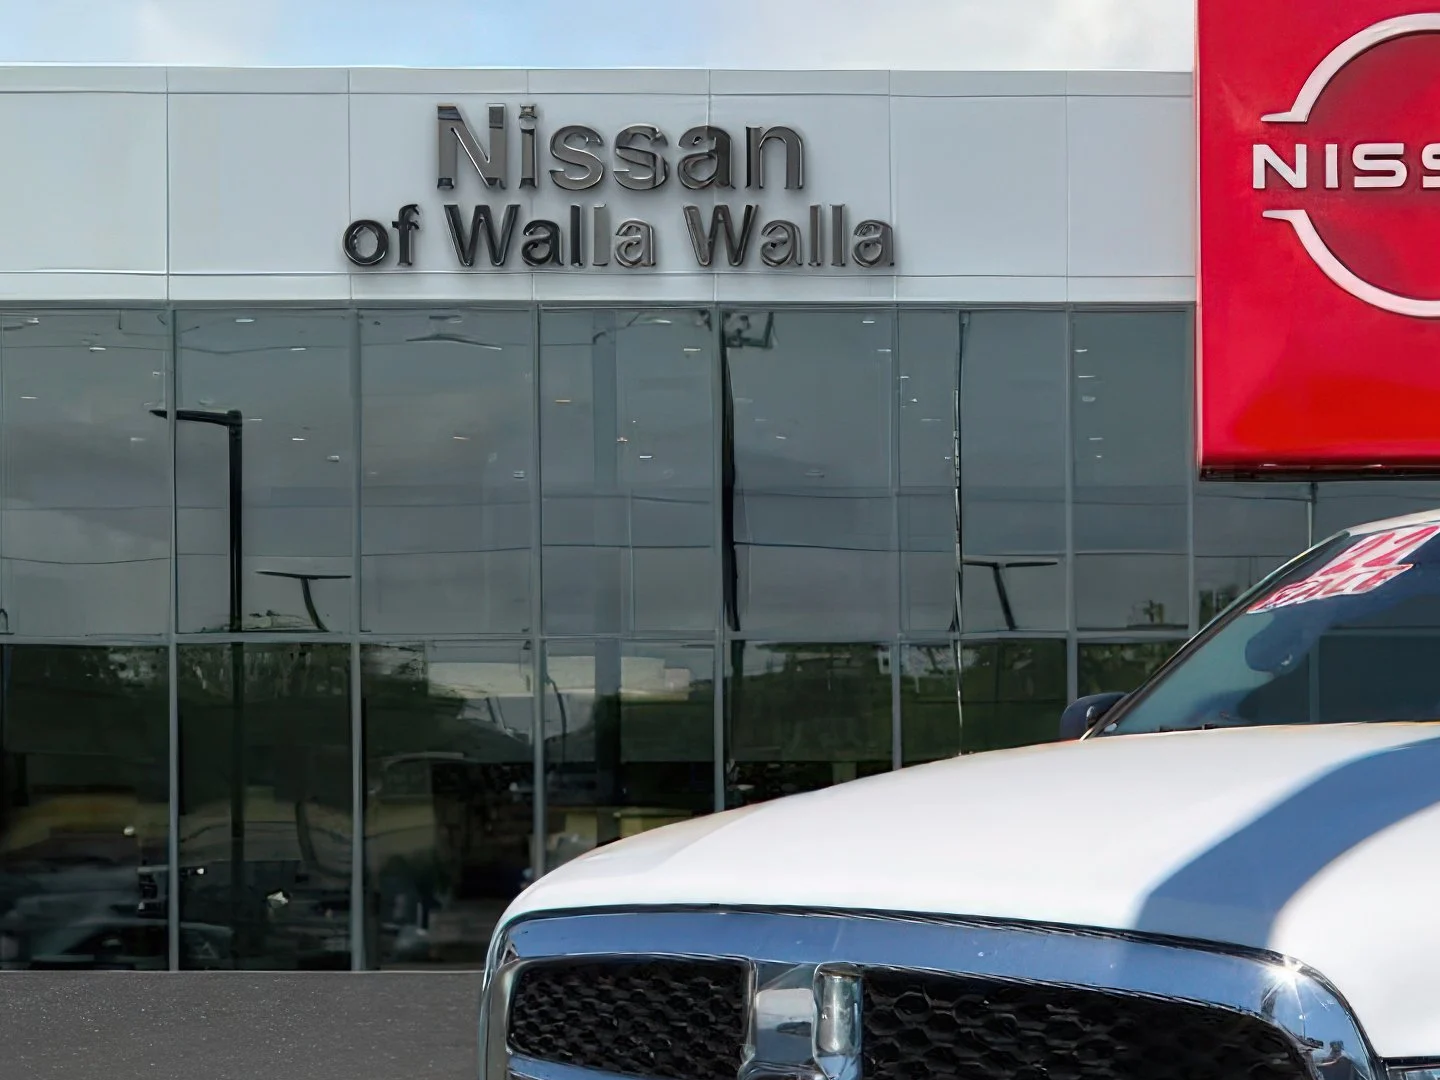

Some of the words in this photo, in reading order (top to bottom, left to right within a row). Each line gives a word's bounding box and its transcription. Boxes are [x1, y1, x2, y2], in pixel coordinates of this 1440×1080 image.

[436, 103, 805, 190] Nissan
[342, 203, 421, 267] of
[444, 203, 657, 267] Walla
[683, 203, 896, 267] Walla
